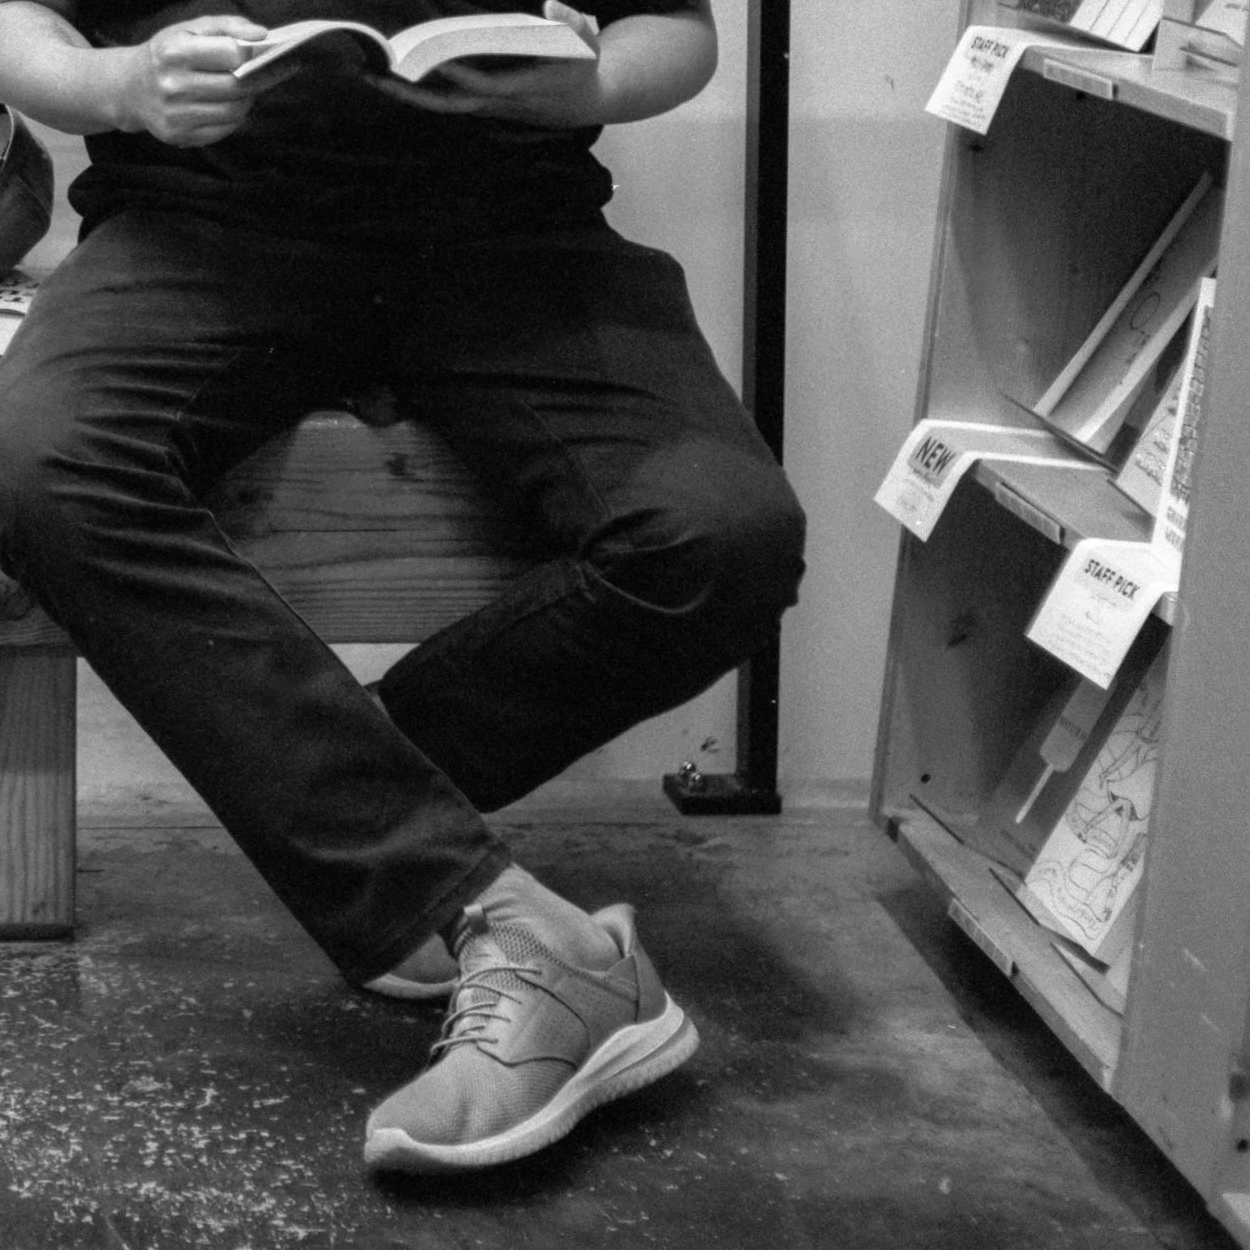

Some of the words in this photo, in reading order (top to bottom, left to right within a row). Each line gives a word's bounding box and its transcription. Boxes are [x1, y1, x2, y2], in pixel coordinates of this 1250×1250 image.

[970, 36, 995, 52] STAFF
[915, 436, 956, 478] NEW
[1084, 559, 1117, 584] STAFF
[1112, 575, 1141, 600] PICK
